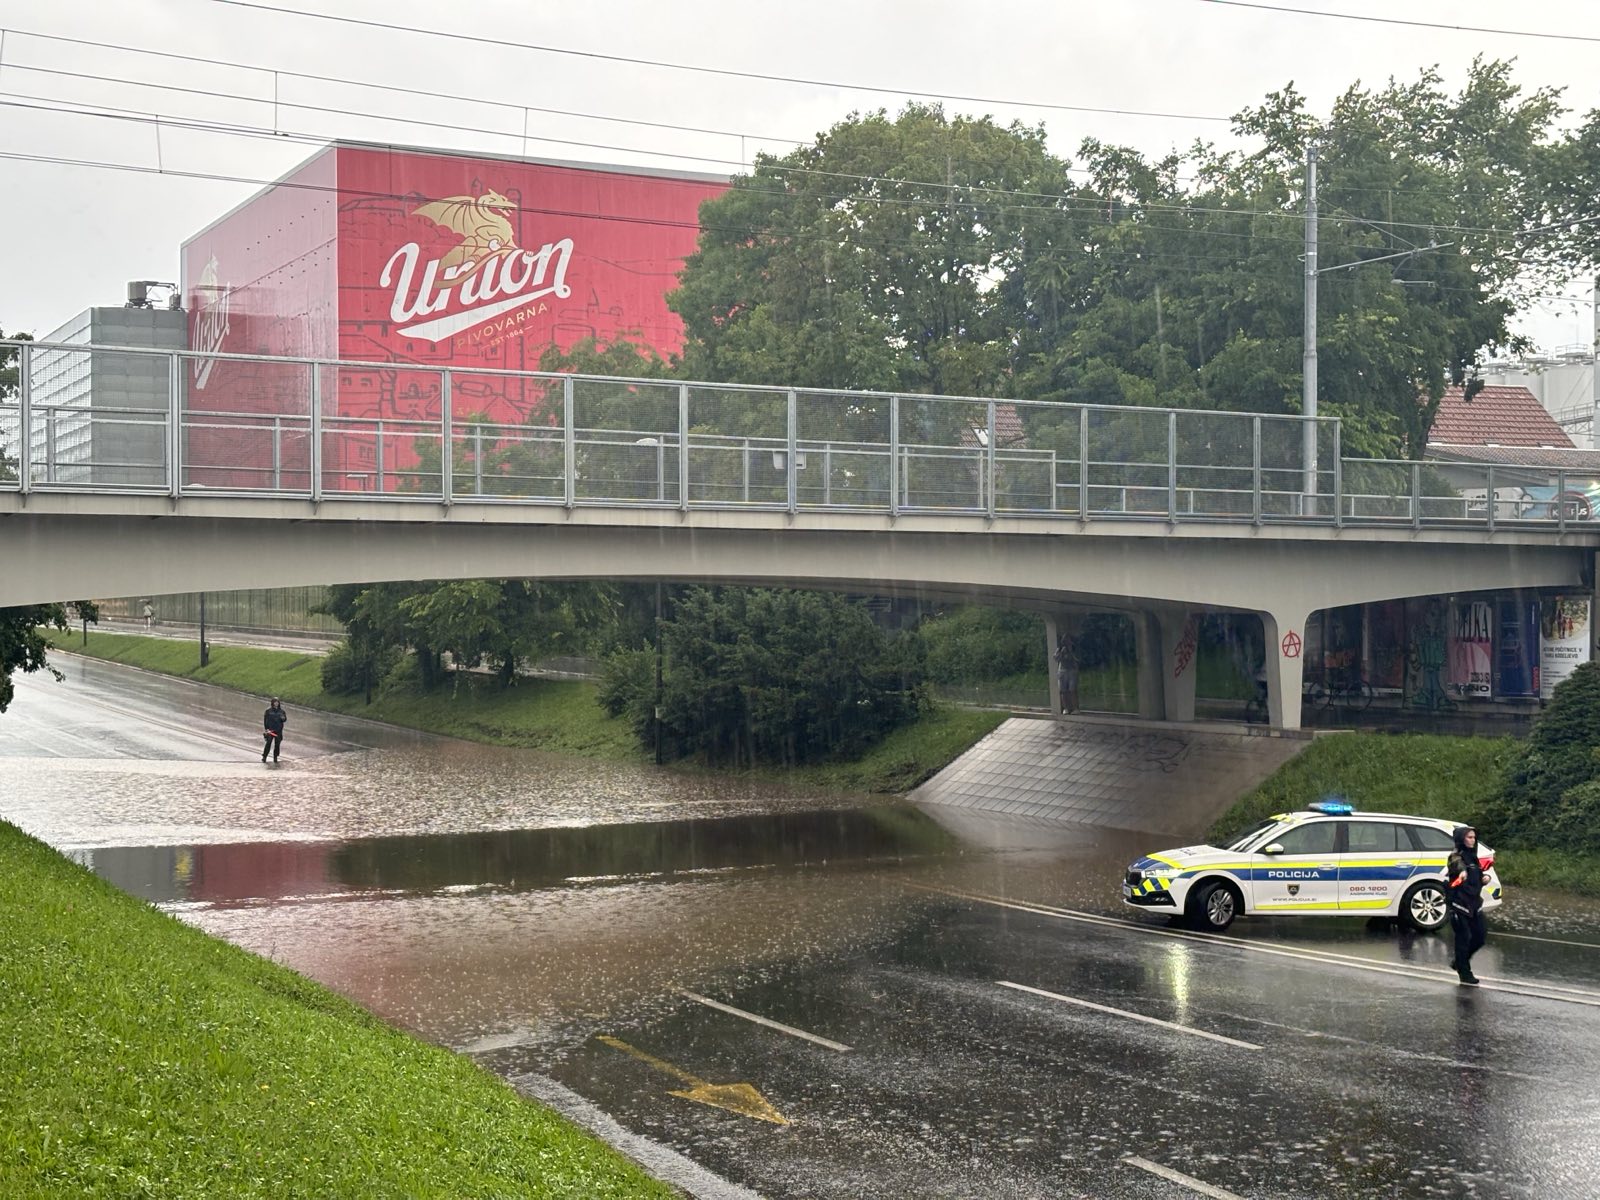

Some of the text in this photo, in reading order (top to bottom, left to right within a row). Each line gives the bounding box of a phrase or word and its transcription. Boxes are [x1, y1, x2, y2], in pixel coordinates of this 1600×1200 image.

[379, 238, 574, 323] Union
[457, 303, 547, 349] PIVOVARNA
[1268, 870, 1320, 878] POLICIJA
